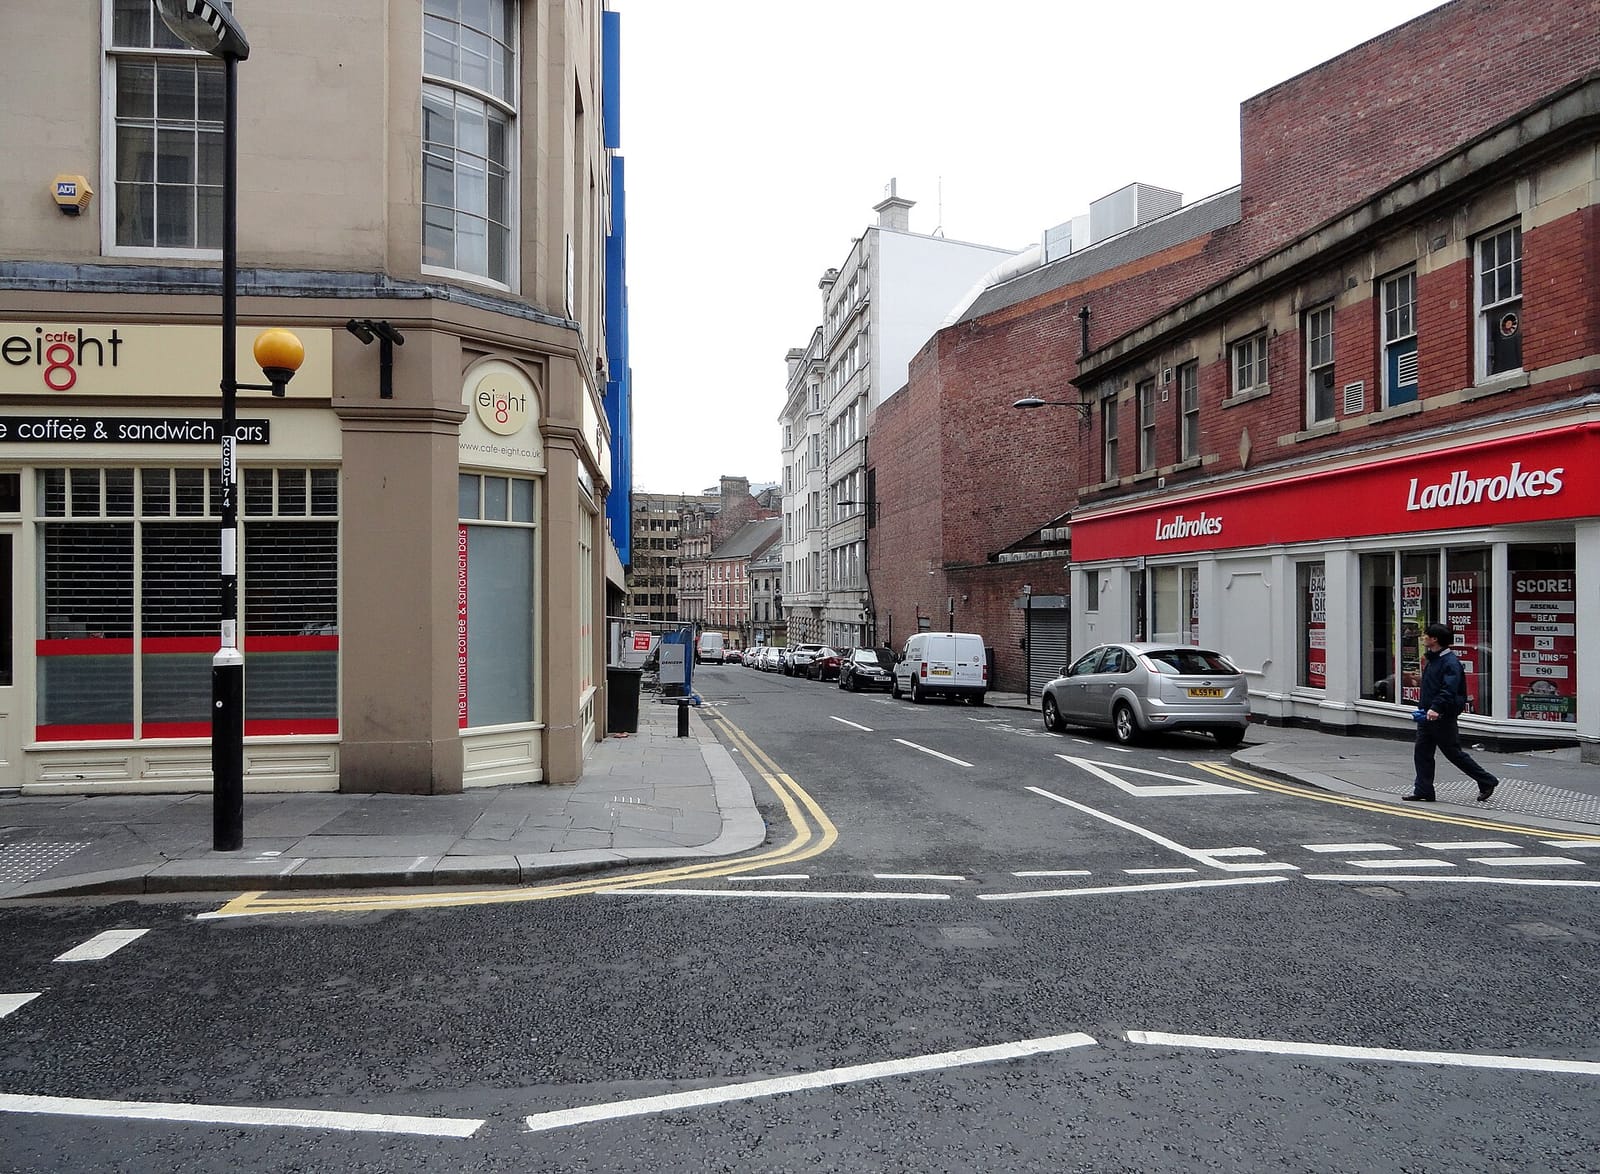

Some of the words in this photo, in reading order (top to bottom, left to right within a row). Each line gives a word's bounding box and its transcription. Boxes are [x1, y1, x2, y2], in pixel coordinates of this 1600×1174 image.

[58, 184, 75, 194] ADT
[45, 331, 76, 342] cafe
[18, 420, 86, 440] coffee
[93, 422, 108, 439] &
[118, 421, 215, 440] sandwich
[235, 426, 263, 440] ars
[459, 443, 541, 458] www.cafe-eight.co.uk
[1407, 462, 1564, 511] Ladbrokes
[1155, 511, 1223, 541] Ladbrokes
[458, 529, 467, 552] bars
[458, 555, 467, 605] sandwich
[1516, 579, 1572, 593] SCORE!
[1406, 586, 1421, 598] £50
[458, 607, 467, 615] &
[1451, 615, 1471, 624] SCORE
[1537, 614, 1557, 622] BEAT
[458, 619, 467, 654] coffee
[1539, 653, 1559, 662] WINS
[458, 656, 467, 699] ultimate
[1536, 667, 1552, 676] £90
[1521, 703, 1530, 711] AS
